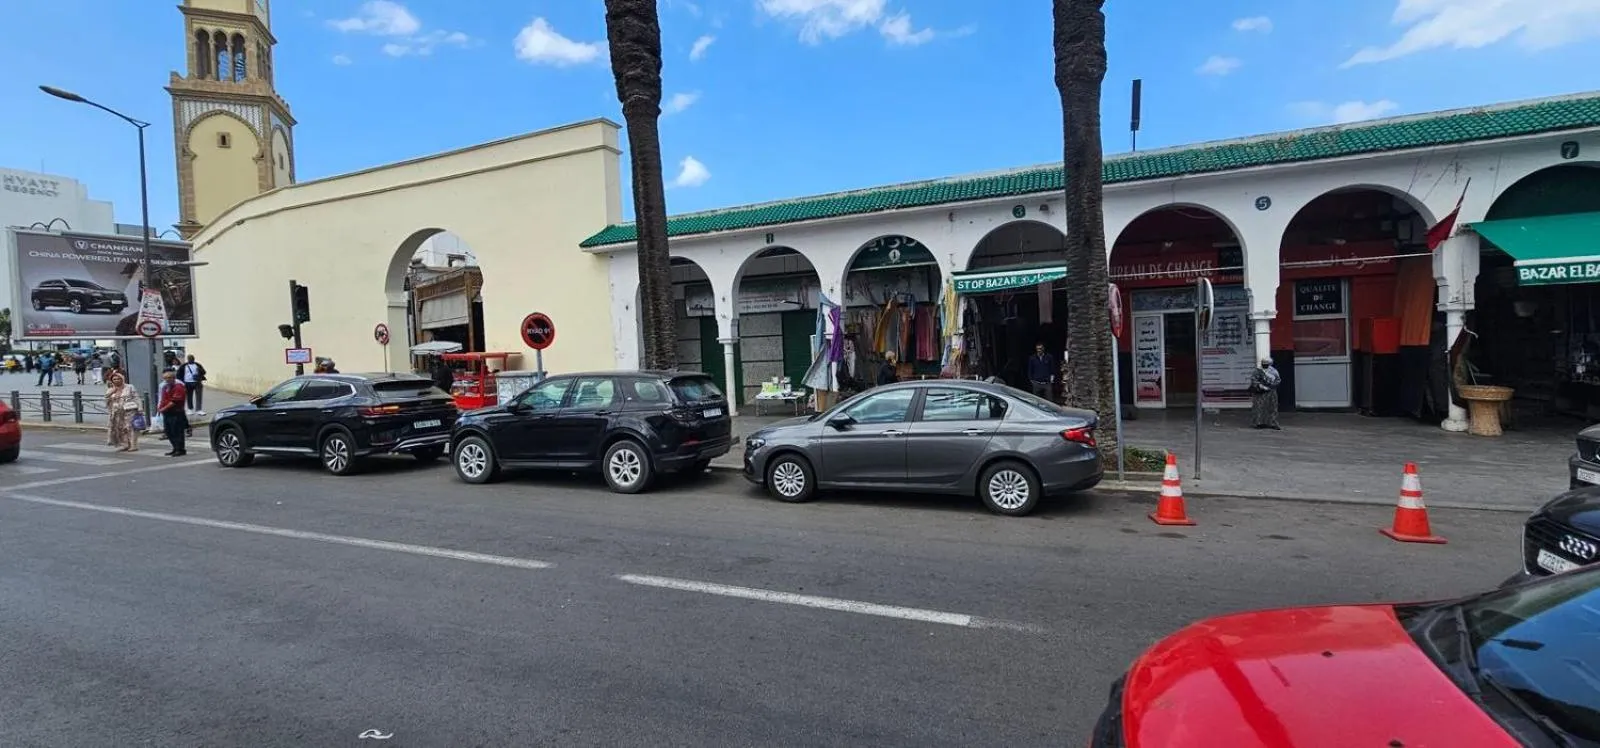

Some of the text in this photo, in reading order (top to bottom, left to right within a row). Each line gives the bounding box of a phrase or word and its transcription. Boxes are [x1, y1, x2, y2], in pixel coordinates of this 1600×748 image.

[1563, 144, 1577, 159] 7
[3, 174, 60, 189] HYATT
[4, 184, 60, 198] REGENCY
[1258, 197, 1270, 210] 5
[90, 243, 143, 253] CHANGAN
[28, 250, 61, 259] CHINA
[113, 256, 138, 264] ITALY
[1150, 263, 1163, 279] DE
[1167, 259, 1213, 279] CHANGE
[1520, 265, 1567, 280] BAZAR
[957, 279, 985, 289] STOP
[985, 276, 1017, 288] BAZAR
[1300, 302, 1337, 311] CHANGE
